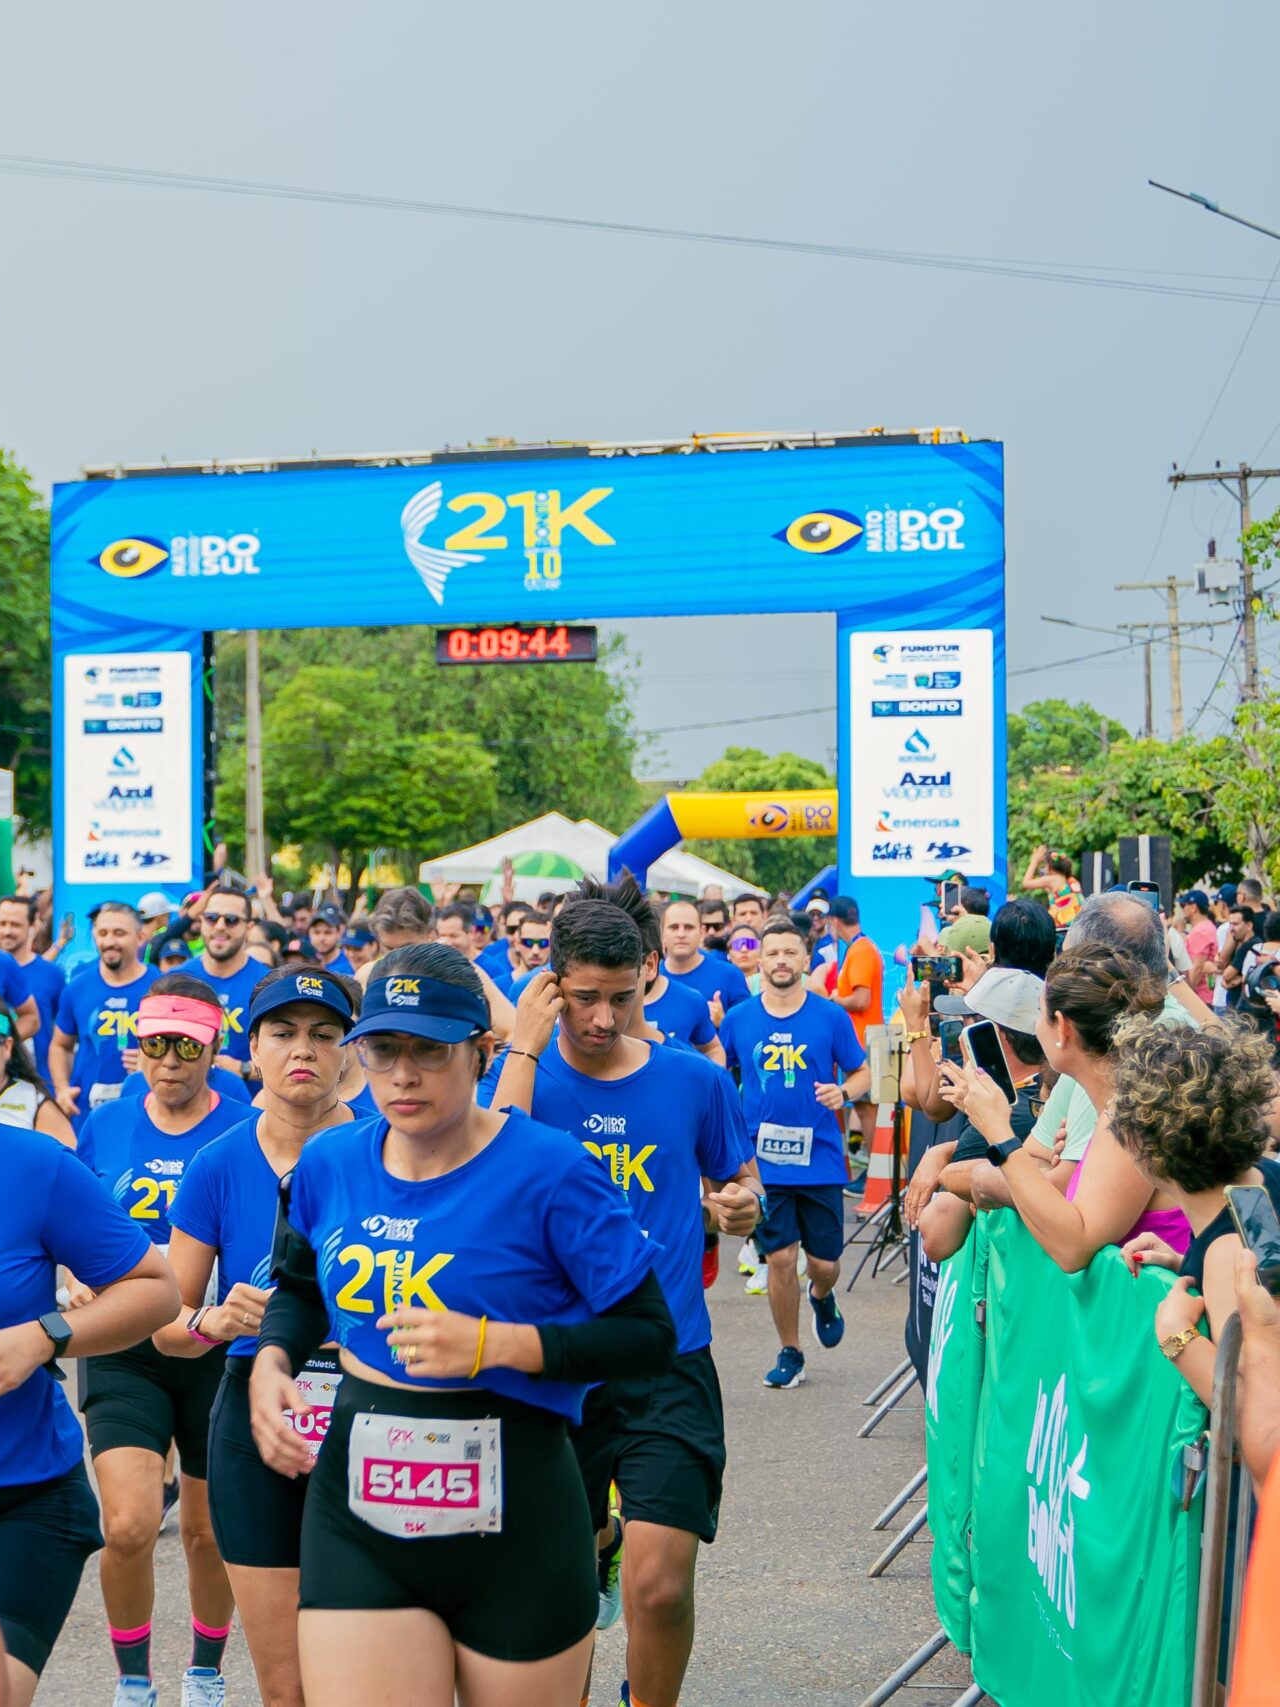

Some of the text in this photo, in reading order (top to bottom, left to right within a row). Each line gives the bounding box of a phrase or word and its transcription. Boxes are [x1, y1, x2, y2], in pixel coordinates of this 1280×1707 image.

[445, 487, 616, 550] 21K
[899, 508, 965, 533] DO
[201, 533, 261, 558] DO
[900, 530, 965, 552] SUL
[202, 556, 261, 576] SUL
[524, 552, 562, 580] 10
[449, 627, 571, 660] 0:09:44
[900, 771, 951, 786] Azul
[391, 979, 421, 993] 21K
[763, 1044, 807, 1070] 21K
[129, 1177, 178, 1218] 21
[336, 1244, 455, 1315] 21K
[392, 1251, 407, 1312] ONITO
[368, 1463, 473, 1502] 5145
